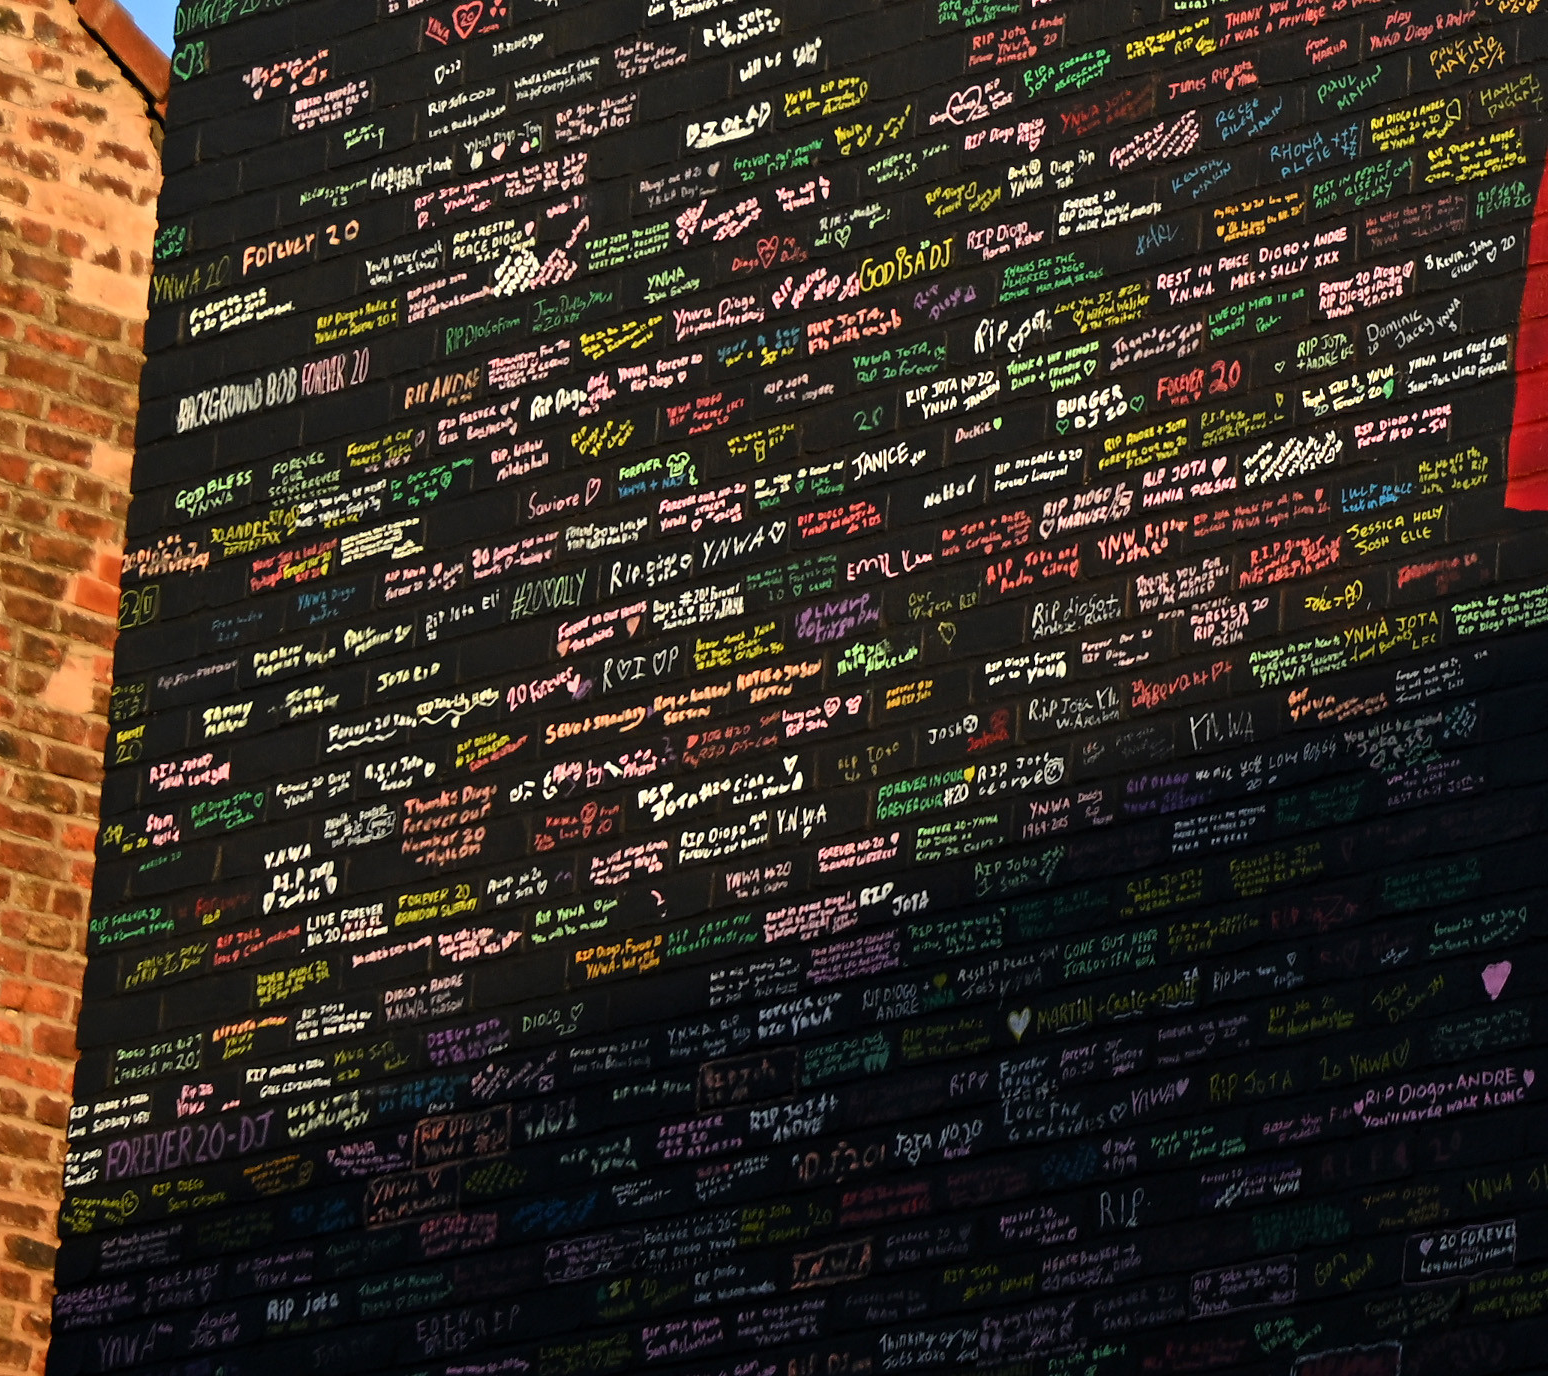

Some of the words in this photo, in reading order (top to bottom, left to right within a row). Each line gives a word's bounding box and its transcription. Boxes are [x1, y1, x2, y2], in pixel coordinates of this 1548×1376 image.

[1225, 6, 1262, 30] THANK
[177, 378, 262, 433] BACKGROUND
[266, 367, 297, 406] BOB
[302, 354, 346, 395] FOREVER
[350, 347, 369, 385] 20
[1057, 385, 1123, 417] BURGER
[852, 442, 908, 480] JANICE
[703, 526, 764, 567] YNWA
[108, 1131, 190, 1175] FOREVER
